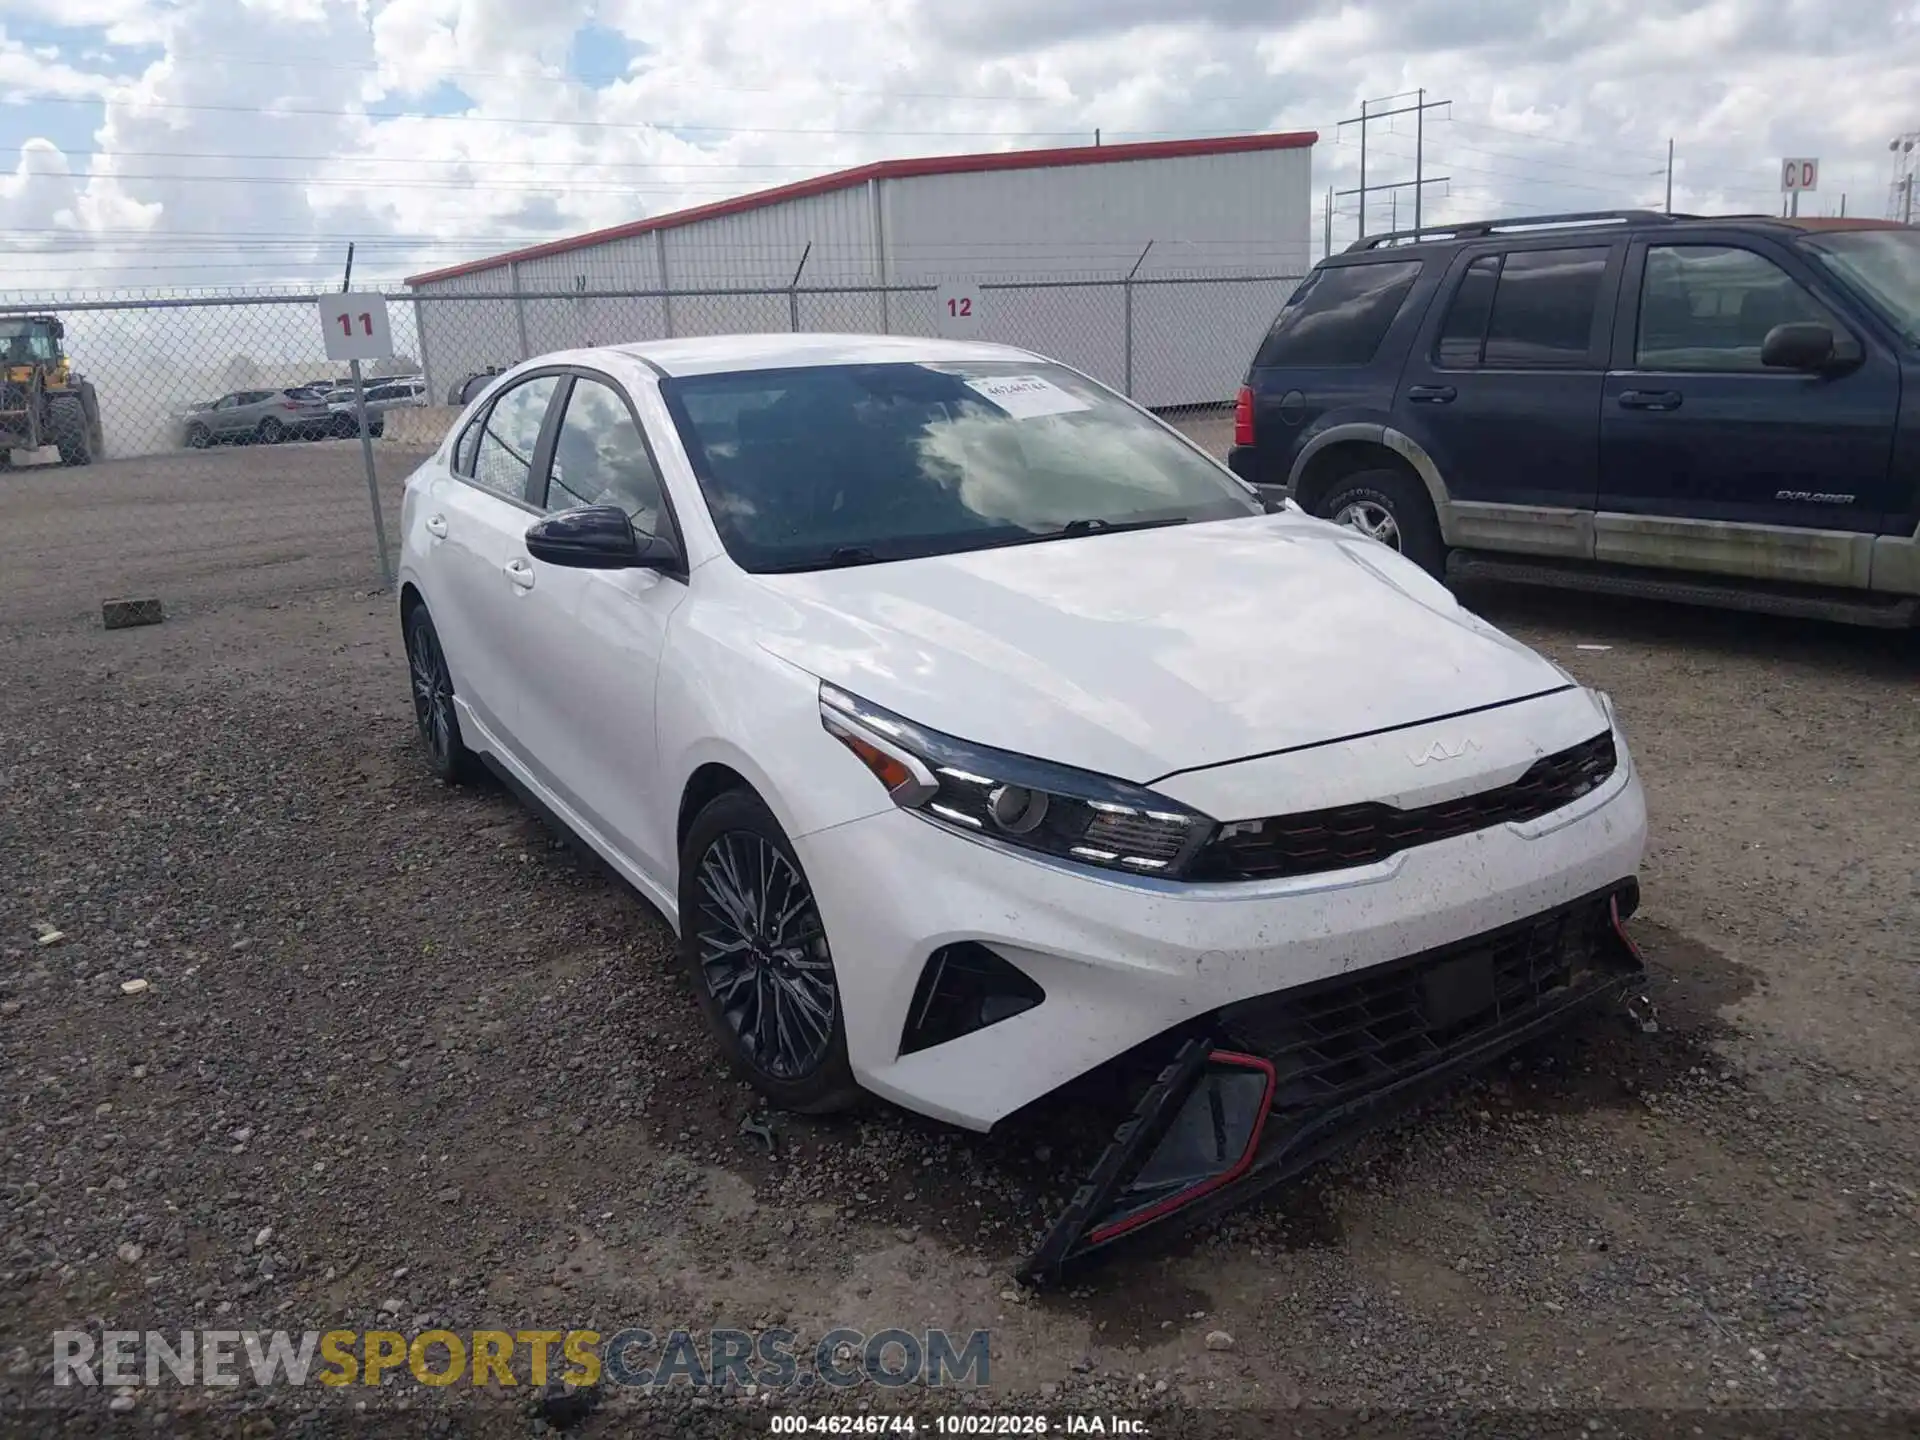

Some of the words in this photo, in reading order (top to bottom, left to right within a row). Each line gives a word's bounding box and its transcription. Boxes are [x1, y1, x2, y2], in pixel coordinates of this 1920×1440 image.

[947, 297, 972, 317] 12
[336, 312, 373, 336] 11
[1775, 490, 1856, 504] EXPLORER
[1404, 738, 1483, 768] KIA
